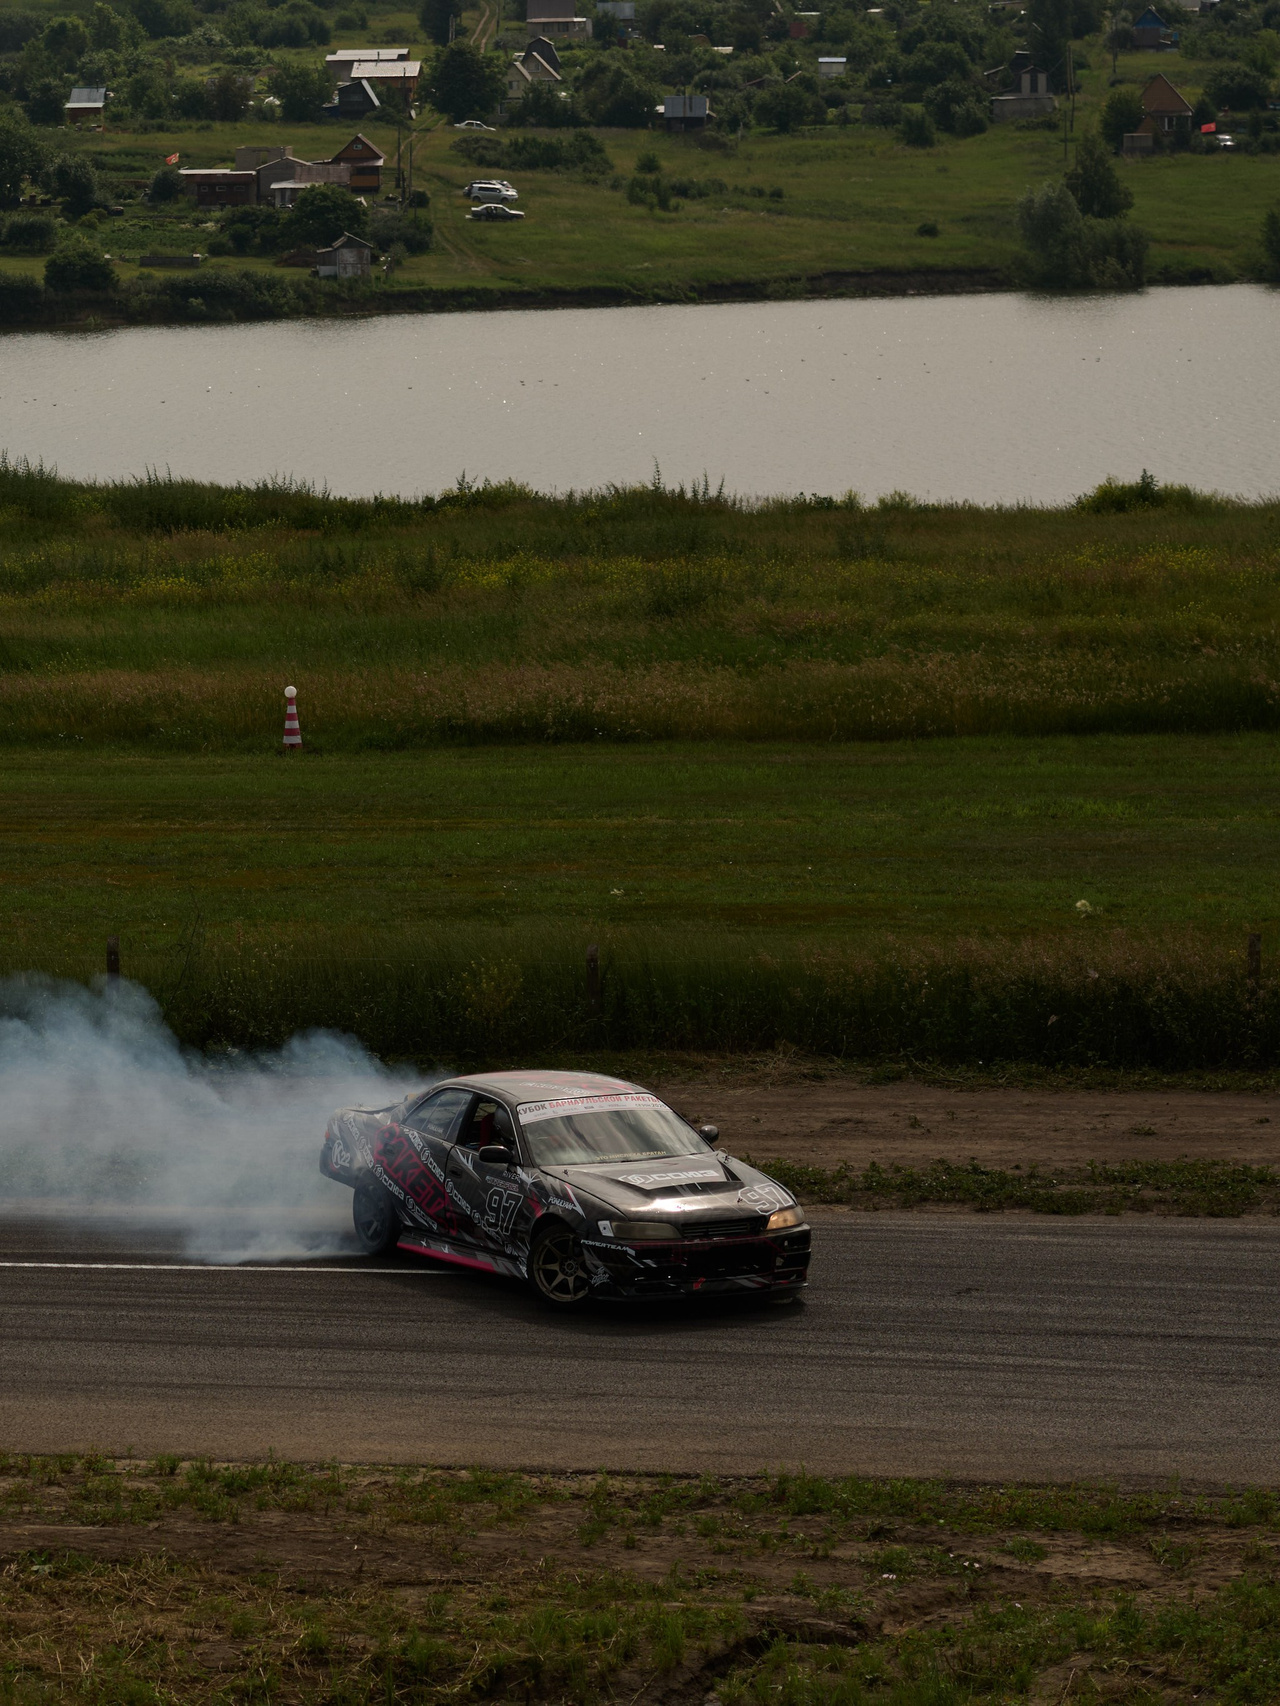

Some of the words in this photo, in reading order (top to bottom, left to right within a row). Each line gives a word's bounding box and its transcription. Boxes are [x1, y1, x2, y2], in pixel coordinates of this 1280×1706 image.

[549, 1095, 622, 1109] БАРНАУЛЬСКОЙ
[654, 1169, 719, 1180] СОЮЗ
[738, 1183, 794, 1216] 97
[485, 1186, 524, 1236] 97
[580, 1239, 628, 1251] POWERTEAM
